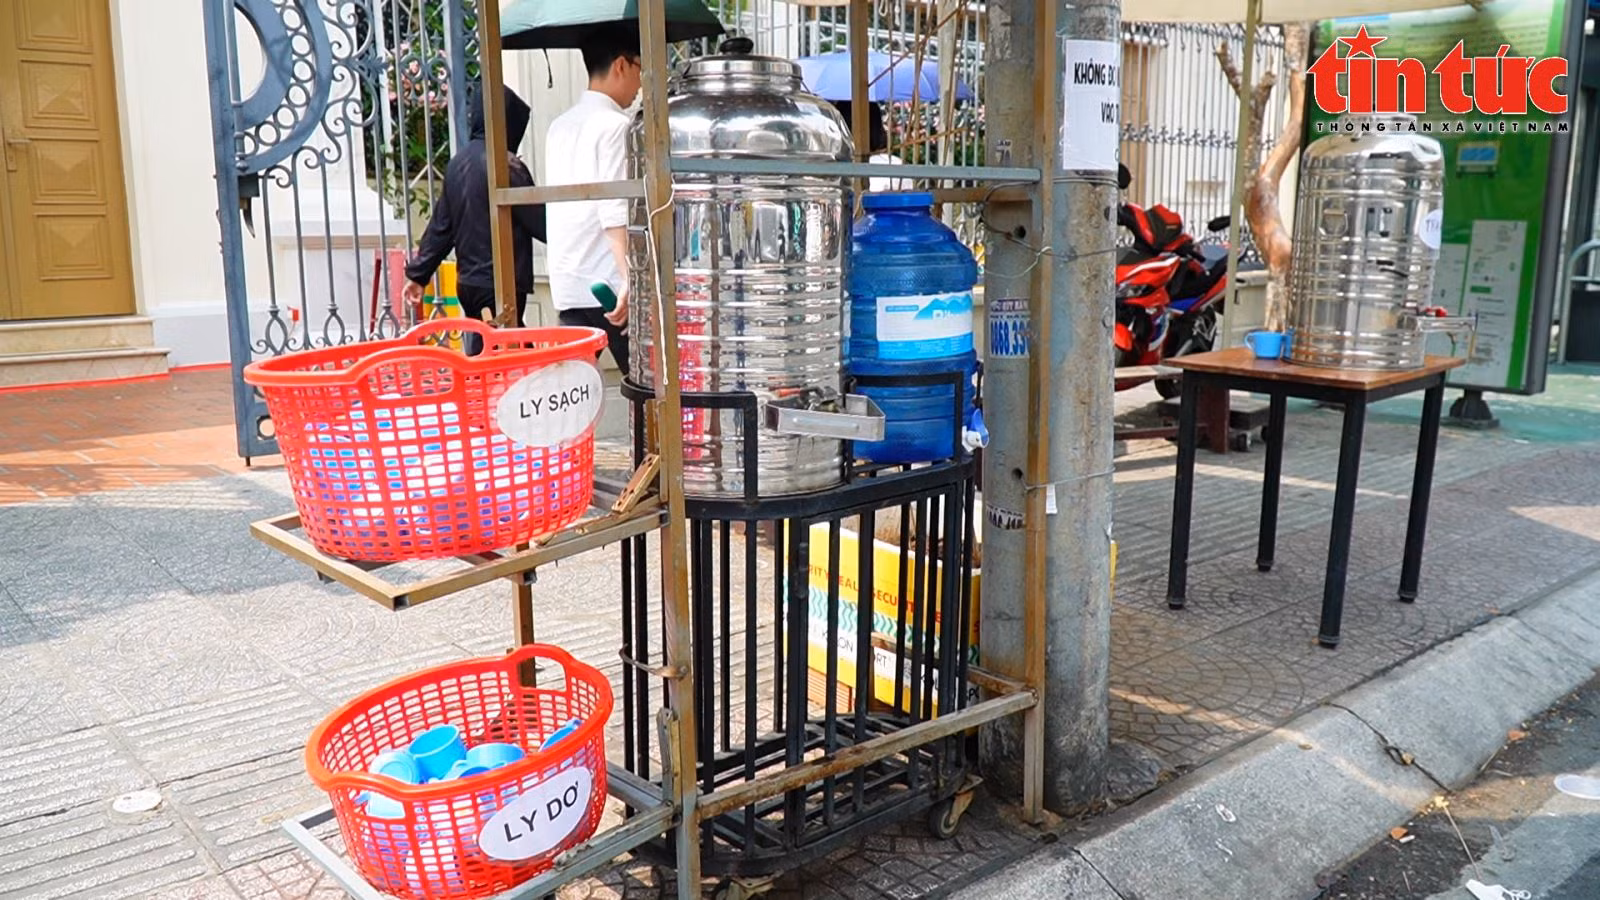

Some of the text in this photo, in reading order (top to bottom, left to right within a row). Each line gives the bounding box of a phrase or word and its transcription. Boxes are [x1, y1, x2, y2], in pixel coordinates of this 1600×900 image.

[1074, 57, 1106, 86] KHÔNG
[519, 383, 590, 419] LY SẠCH
[837, 575, 860, 592] EAL
[503, 780, 579, 842] LY DƠ
